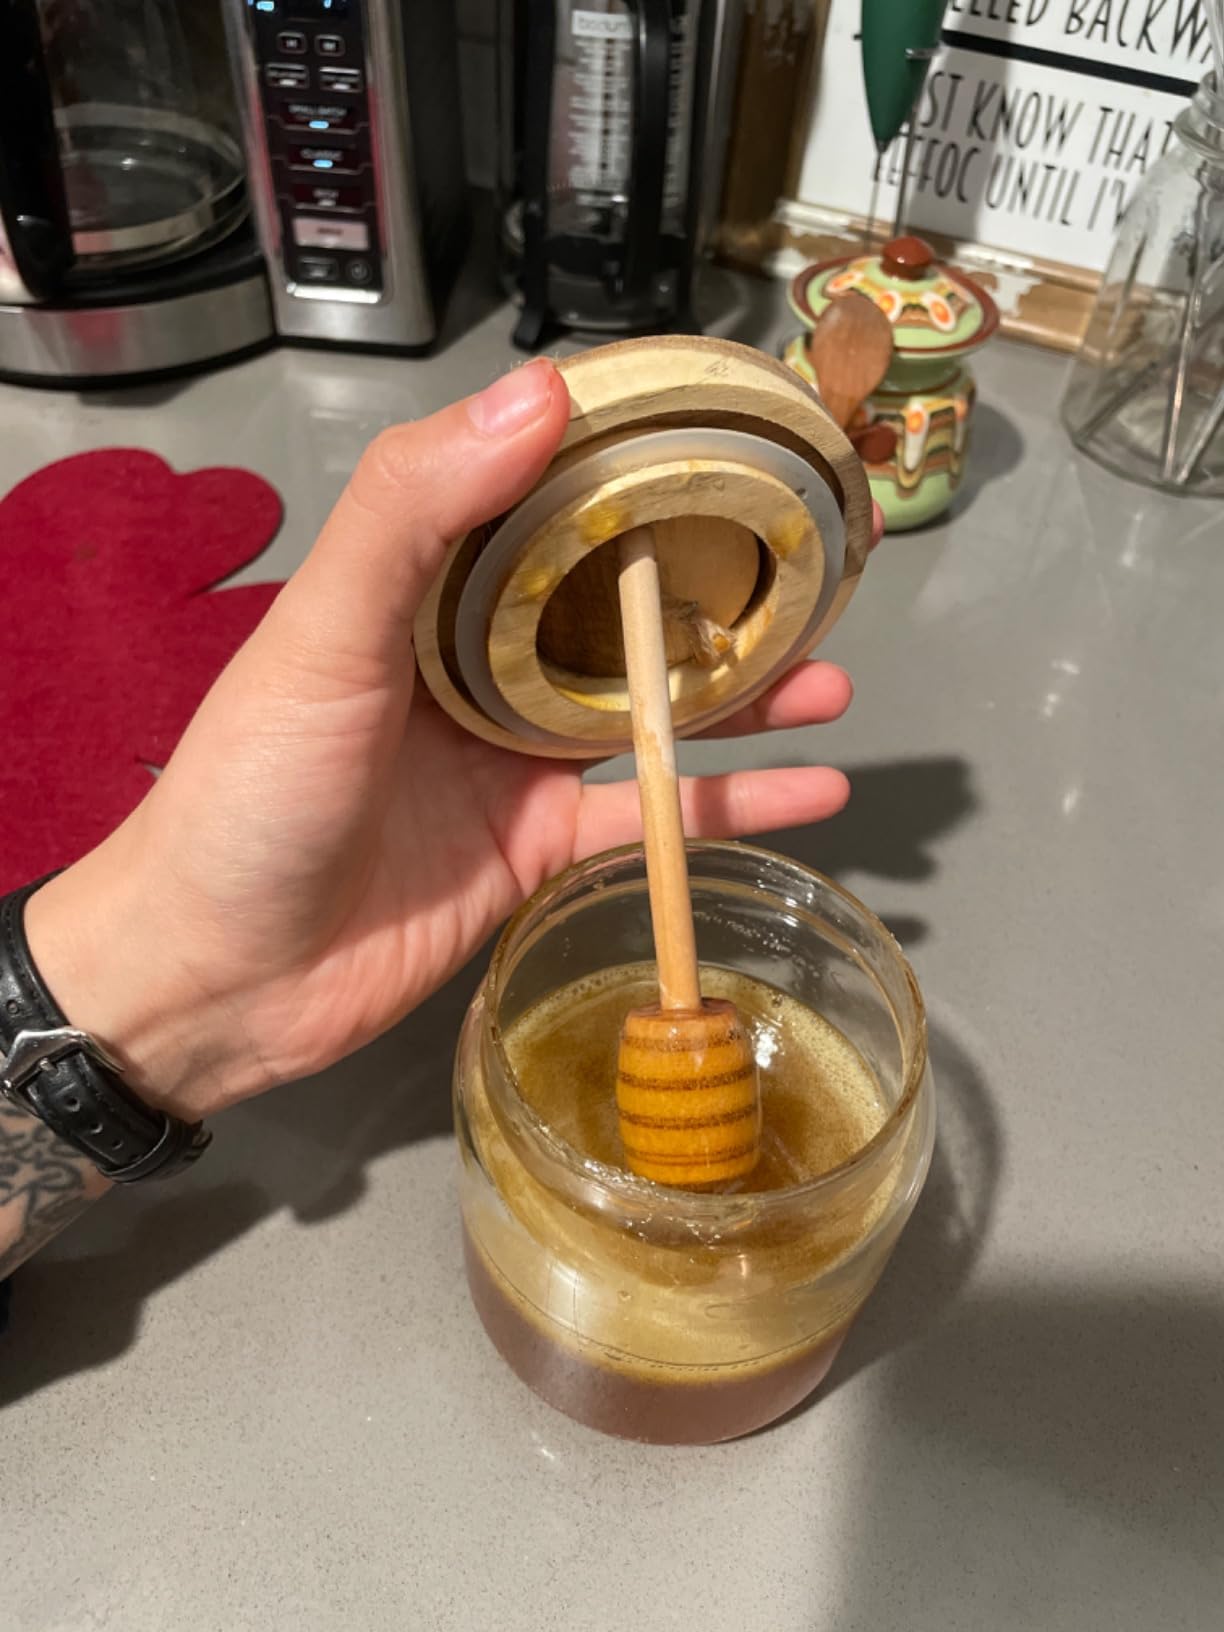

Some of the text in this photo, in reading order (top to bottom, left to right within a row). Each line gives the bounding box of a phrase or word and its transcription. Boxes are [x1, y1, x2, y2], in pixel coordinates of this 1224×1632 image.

[967, 79, 1084, 157] KNOW
[1088, 106, 1173, 175] THAT
[986, 153, 1081, 227] UNTIL
